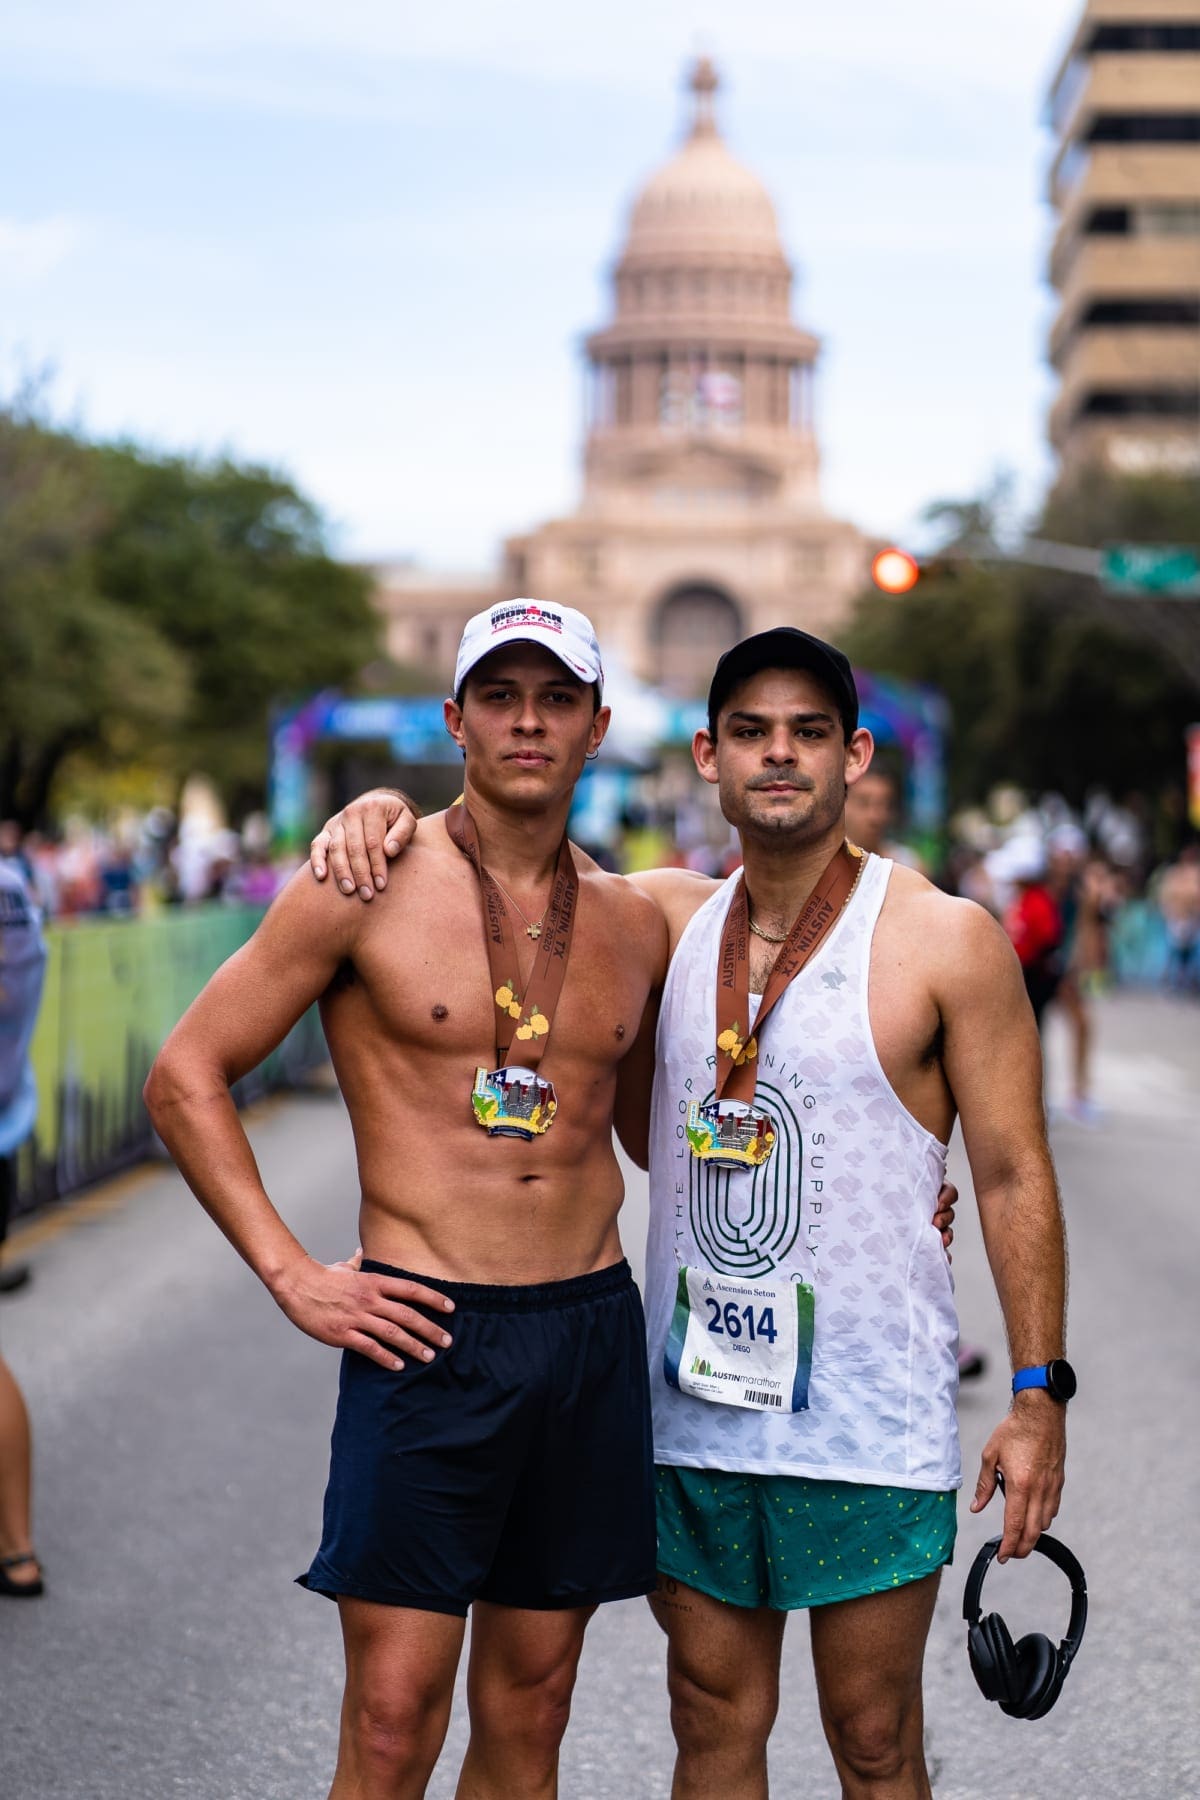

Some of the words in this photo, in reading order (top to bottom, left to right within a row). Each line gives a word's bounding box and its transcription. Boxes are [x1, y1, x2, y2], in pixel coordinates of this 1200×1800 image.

[491, 606, 562, 625] IRONMAN
[789, 895, 822, 946] FEBRUARY
[543, 927, 553, 952] 2020
[553, 942, 567, 960] TX
[738, 937, 746, 961] 2020
[774, 946, 792, 972] 2020
[781, 960, 799, 978] TX
[706, 1053, 816, 1110] RNING
[677, 1078, 693, 1158] LOOP
[806, 1132, 825, 1257] SUPPLY
[675, 1183, 684, 1240] THE
[716, 1282, 753, 1296] Ascension
[753, 1288, 776, 1298] Seton
[705, 1298, 778, 1344] 2614
[733, 1344, 751, 1353] DIEGO
